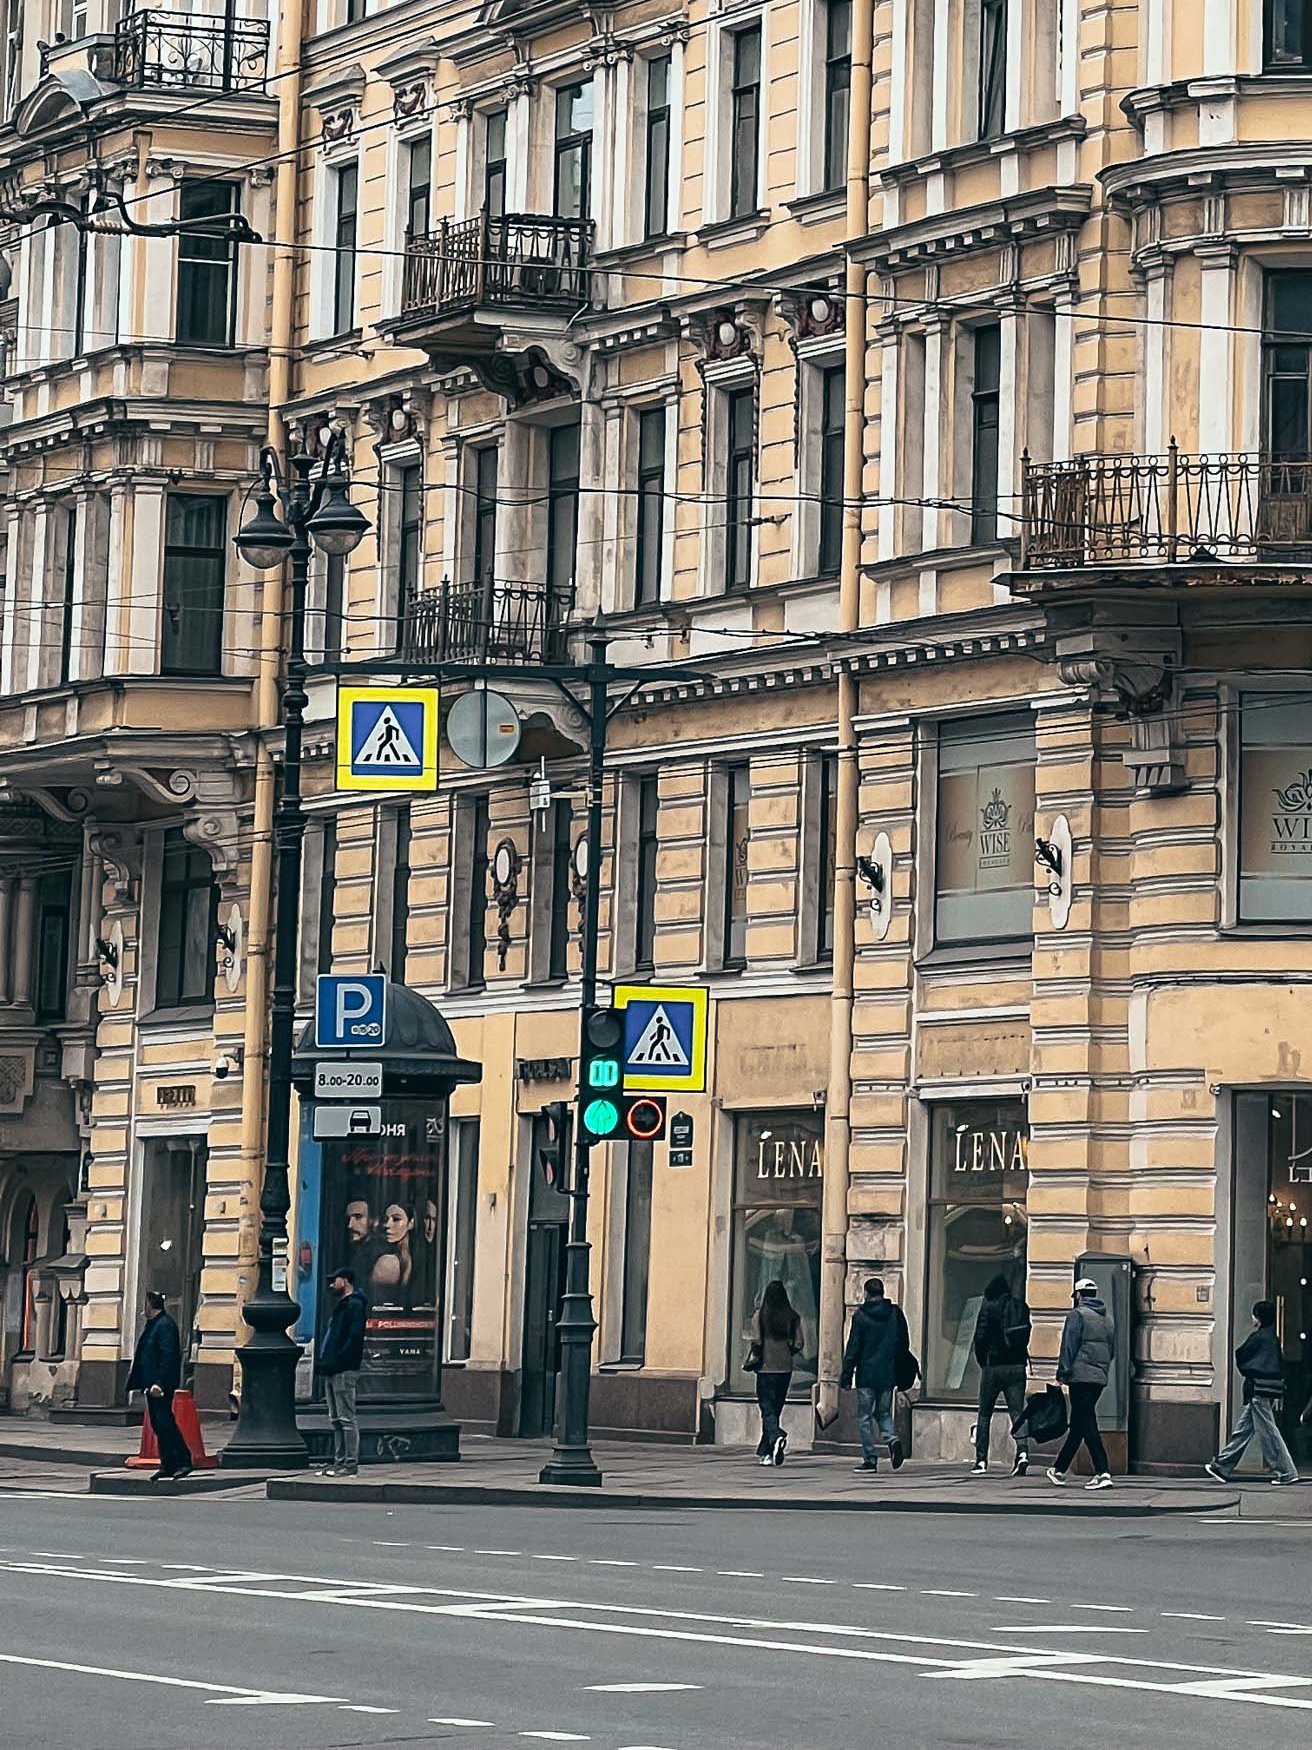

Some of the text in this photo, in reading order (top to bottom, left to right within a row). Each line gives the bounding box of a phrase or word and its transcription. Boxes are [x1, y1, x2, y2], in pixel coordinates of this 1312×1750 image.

[980, 832, 1010, 855] WISE
[336, 983, 373, 1038] P
[318, 1073, 379, 1086] 8.00-20.00
[589, 1060, 619, 1087] 00
[757, 1139, 823, 1179] LENA
[953, 1131, 1025, 1172] LENA
